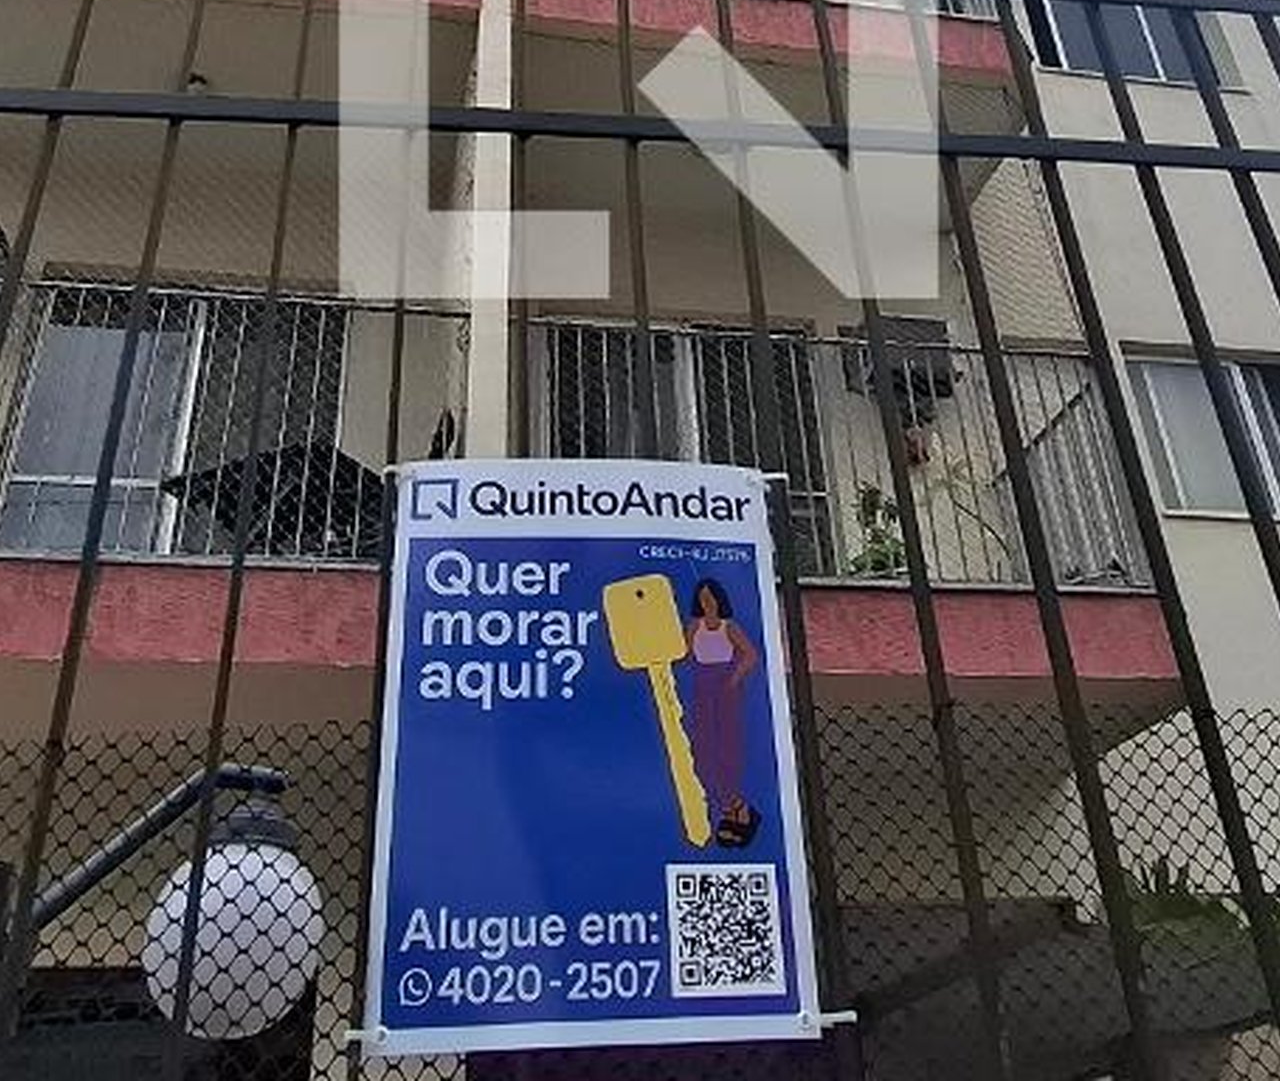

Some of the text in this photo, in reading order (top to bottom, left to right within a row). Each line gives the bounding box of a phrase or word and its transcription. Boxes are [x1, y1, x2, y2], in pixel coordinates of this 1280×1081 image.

[468, 480, 751, 521] QuintoAndar
[425, 549, 570, 597] Quer
[422, 609, 598, 646] morar
[419, 649, 585, 710] aqui?
[399, 907, 660, 959] Alugue em:
